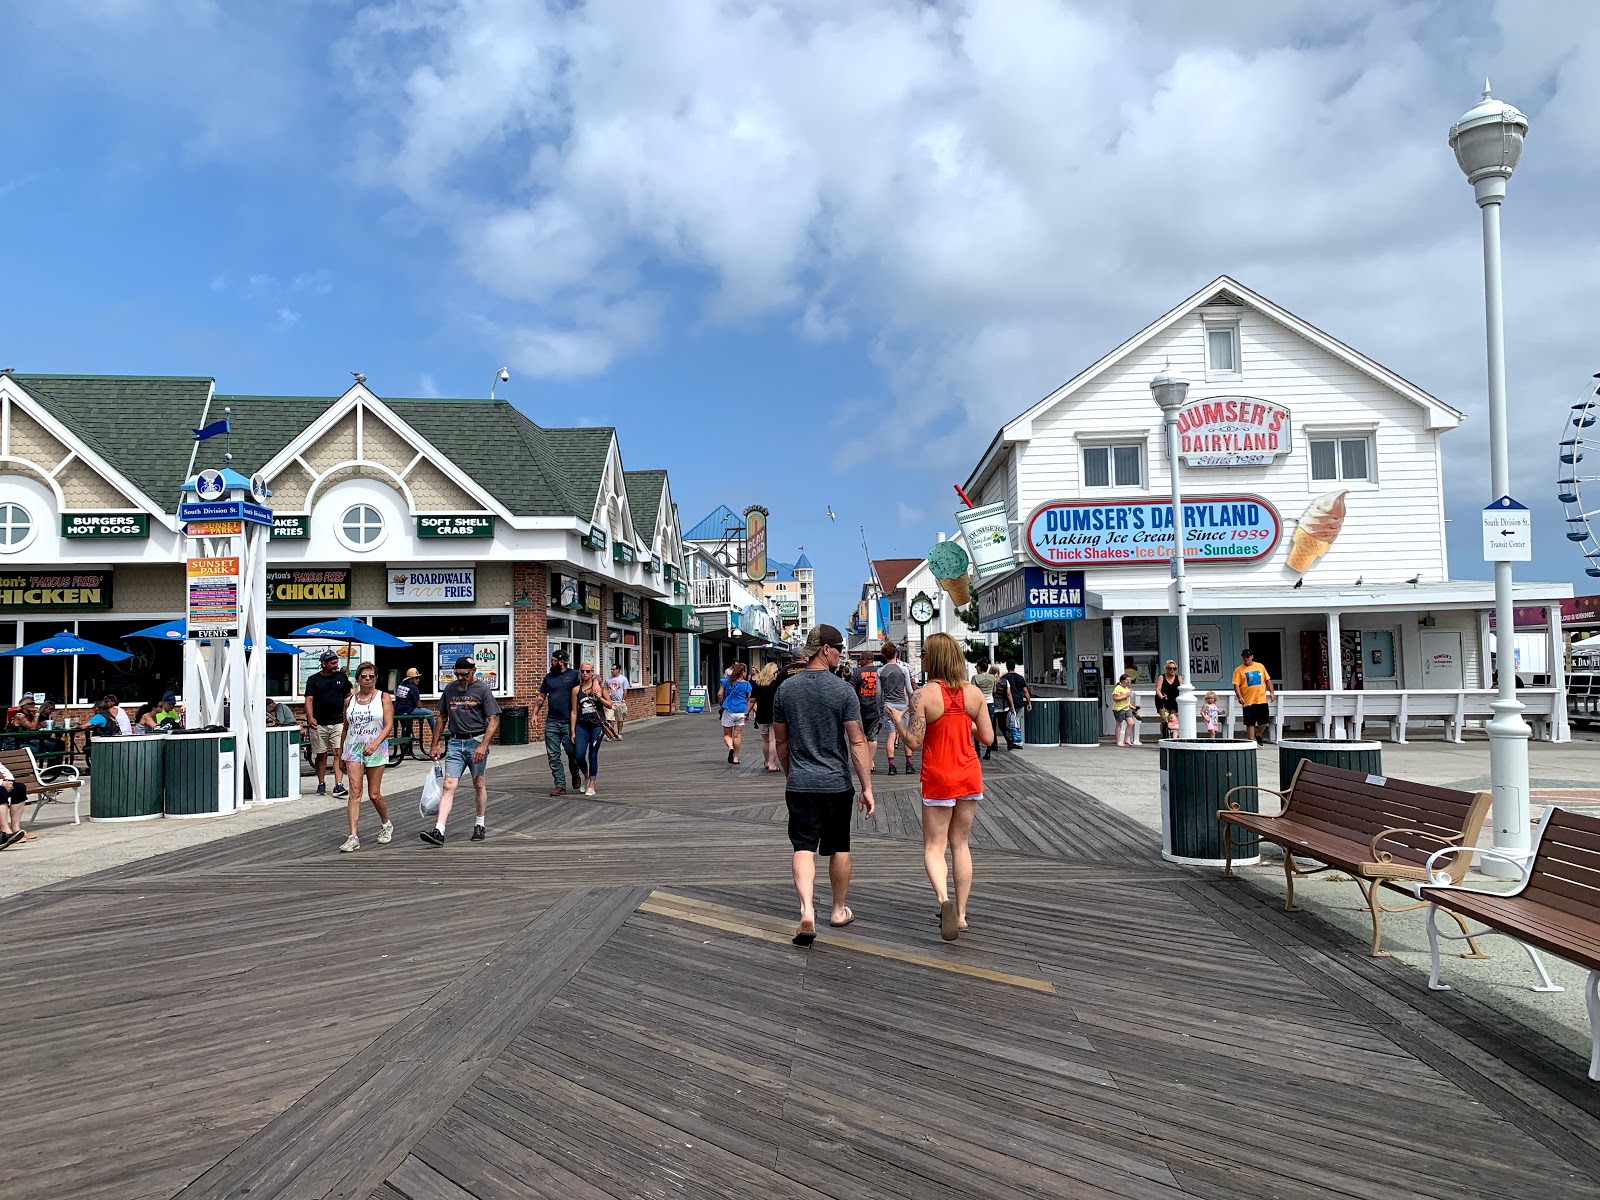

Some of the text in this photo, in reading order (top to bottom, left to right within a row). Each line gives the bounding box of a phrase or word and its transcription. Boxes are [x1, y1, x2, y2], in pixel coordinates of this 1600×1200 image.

[1176, 400, 1286, 434] DUMSER'S
[1181, 432, 1279, 452] DAIRYLAND
[1197, 455, 1232, 465] Since
[183, 508, 202, 516] South
[203, 507, 228, 515] Division
[73, 516, 135, 526] BURGERS
[421, 518, 489, 527] SOFT SHELL
[1046, 504, 1260, 532] DUMSER'S DARYLAND
[1484, 517, 1530, 527] South Division St.
[67, 525, 141, 534] HOT DOGS
[203, 521, 238, 529] SUNSET
[437, 526, 474, 535] CRABS
[274, 527, 304, 536] FRIES
[747, 530, 765, 550] PLAY
[1035, 532, 1102, 547] Making
[1105, 531, 1129, 545] Ice
[1185, 529, 1227, 541] Since
[1230, 529, 1270, 541] 1939
[1490, 539, 1526, 548] Transit Center
[747, 542, 766, 562] LAND
[1047, 547, 1082, 560] Thick
[1084, 546, 1130, 559] Shakes
[1135, 545, 1155, 558] Ice
[1203, 543, 1259, 556] Sundaes
[191, 559, 235, 568] SUNSET
[200, 567, 230, 575] PARK
[266, 571, 291, 581] ayton's
[0, 575, 27, 587] ton's
[410, 572, 472, 585] BOARDWALK
[1043, 570, 1068, 586] ICE
[0, 588, 101, 604] HICKEN
[276, 583, 346, 600] CHICKEN
[444, 586, 473, 598] FRIES
[1029, 588, 1081, 605] CREAM
[1029, 607, 1083, 619] DUMSER'S
[198, 629, 229, 638] EVENTS
[1190, 633, 1209, 652] ICE
[56, 646, 85, 654] pepsi
[1189, 655, 1220, 674] REAM
